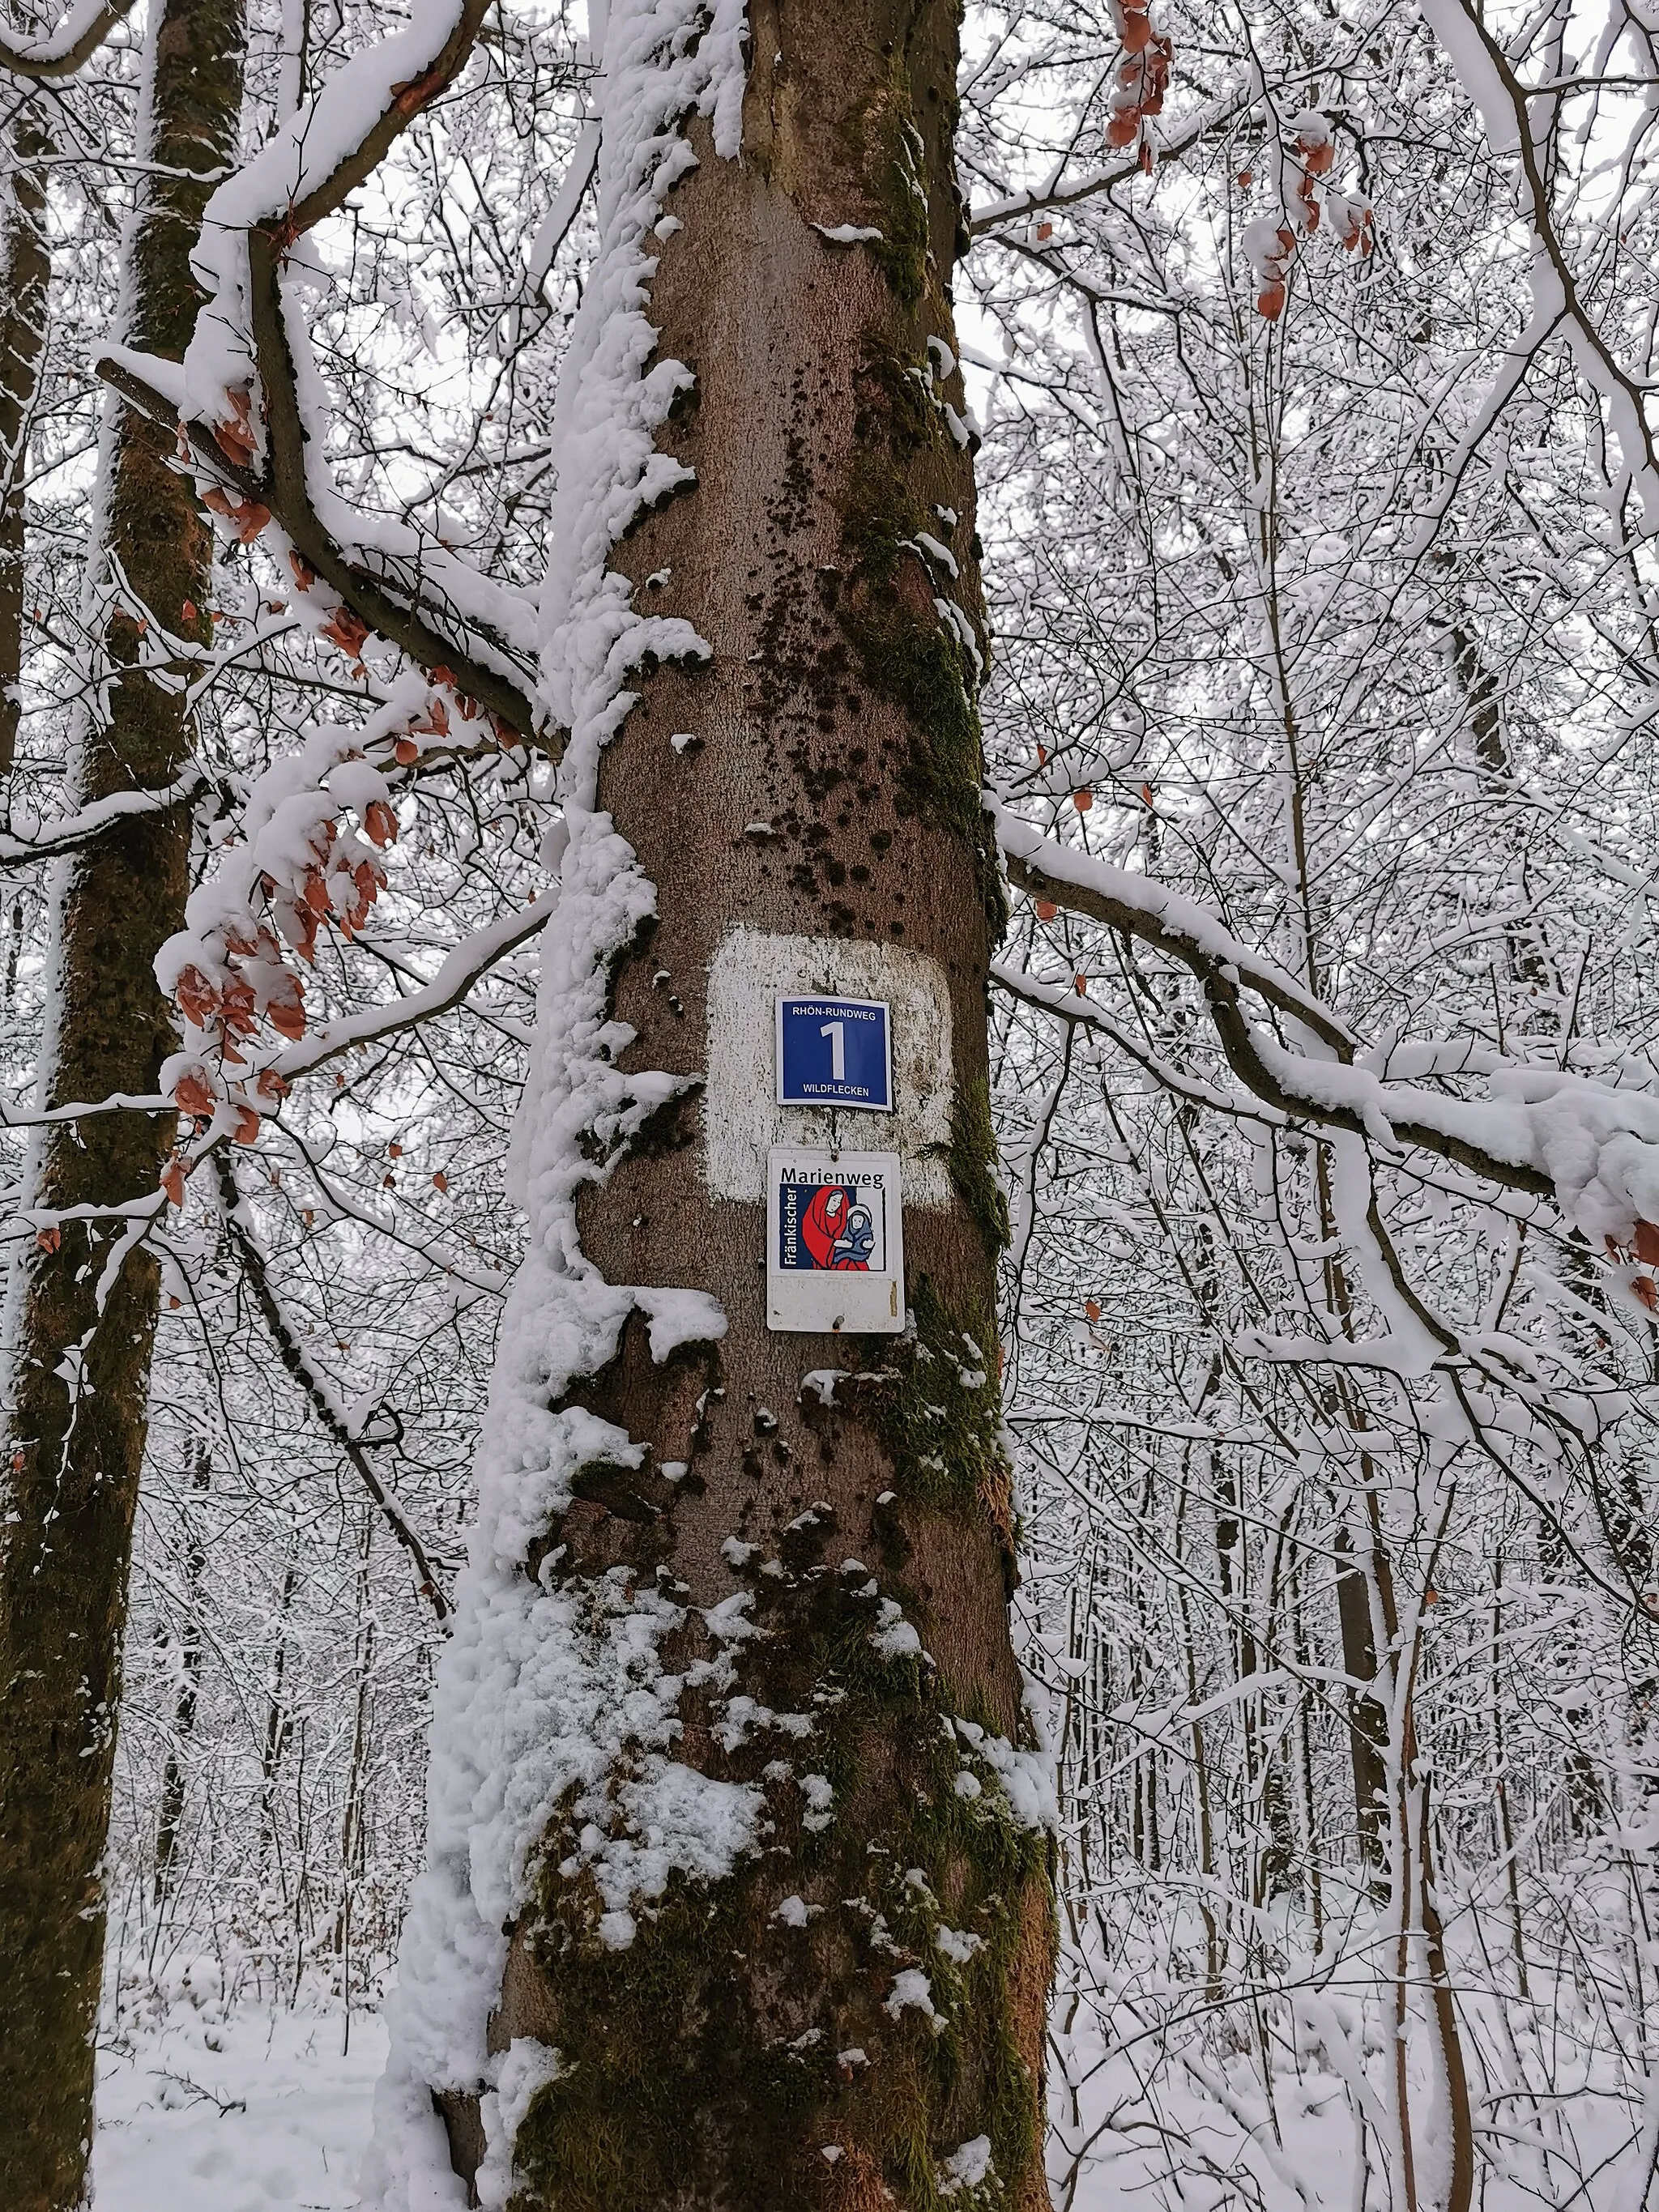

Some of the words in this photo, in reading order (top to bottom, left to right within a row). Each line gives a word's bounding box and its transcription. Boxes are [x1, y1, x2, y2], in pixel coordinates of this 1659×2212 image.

[792, 1005, 876, 1021] RHÖN-RUNDWEG
[820, 1021, 845, 1080] 1
[803, 1084, 869, 1097] WILDFLECKEN
[781, 1167, 884, 1189] Marienweg
[784, 1187, 797, 1265] Fränkischer
